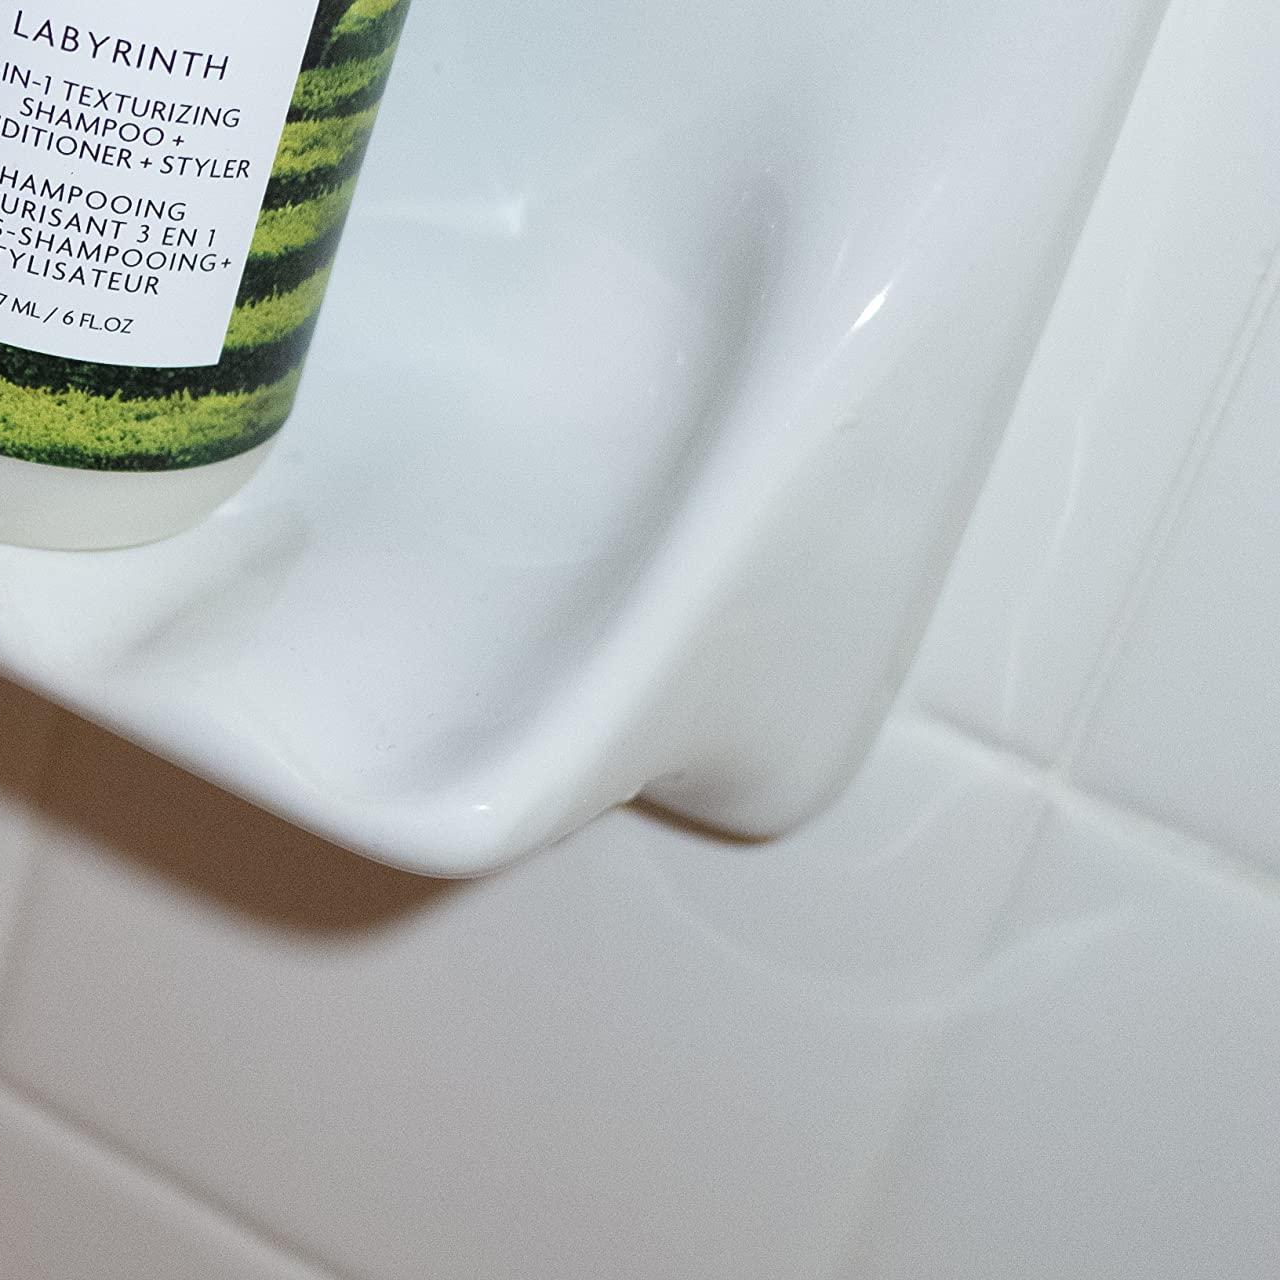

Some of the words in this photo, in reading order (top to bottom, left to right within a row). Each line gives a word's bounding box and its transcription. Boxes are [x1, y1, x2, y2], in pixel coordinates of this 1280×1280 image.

[13, 9, 229, 81] LABYRINTH
[19, 97, 165, 147] SHAMPOO
[63, 80, 241, 128] TEXTURIZING
[159, 155, 251, 179] STYLER
[136, 224, 150, 244] 3
[161, 226, 198, 248] EN
[207, 228, 216, 248] 1
[11, 297, 41, 319] ML
[62, 310, 74, 326] 6
